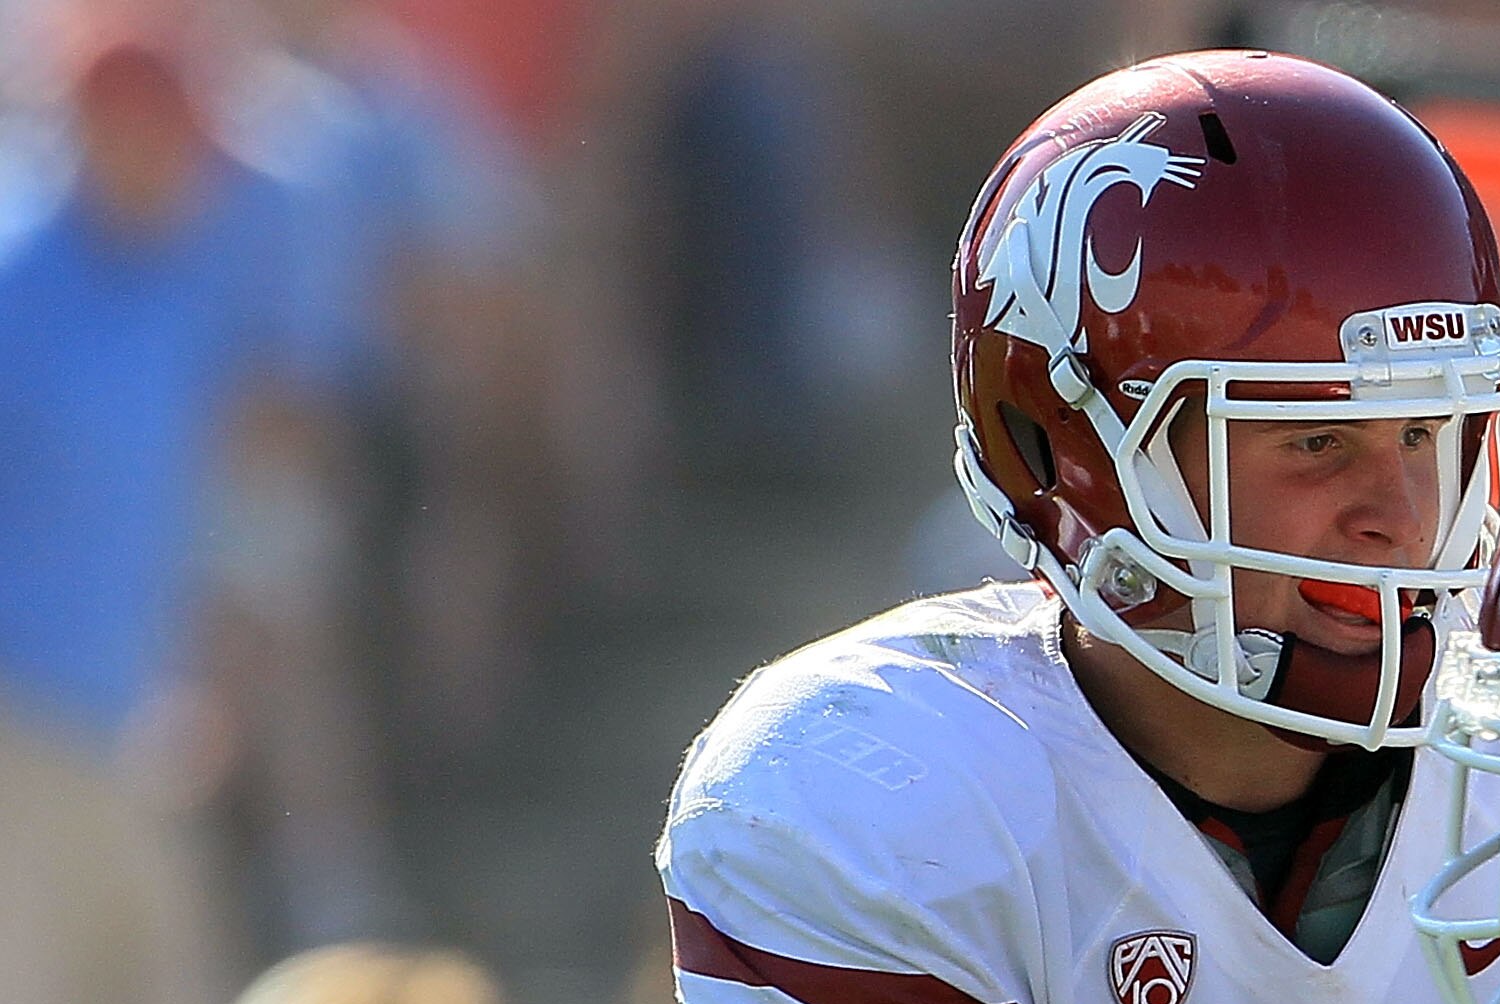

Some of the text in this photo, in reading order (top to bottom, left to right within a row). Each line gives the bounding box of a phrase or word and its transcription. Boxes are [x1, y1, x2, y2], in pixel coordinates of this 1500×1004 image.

[1390, 313, 1465, 342] WSU
[1122, 382, 1151, 396] Ridd
[1113, 935, 1192, 998] PAC
